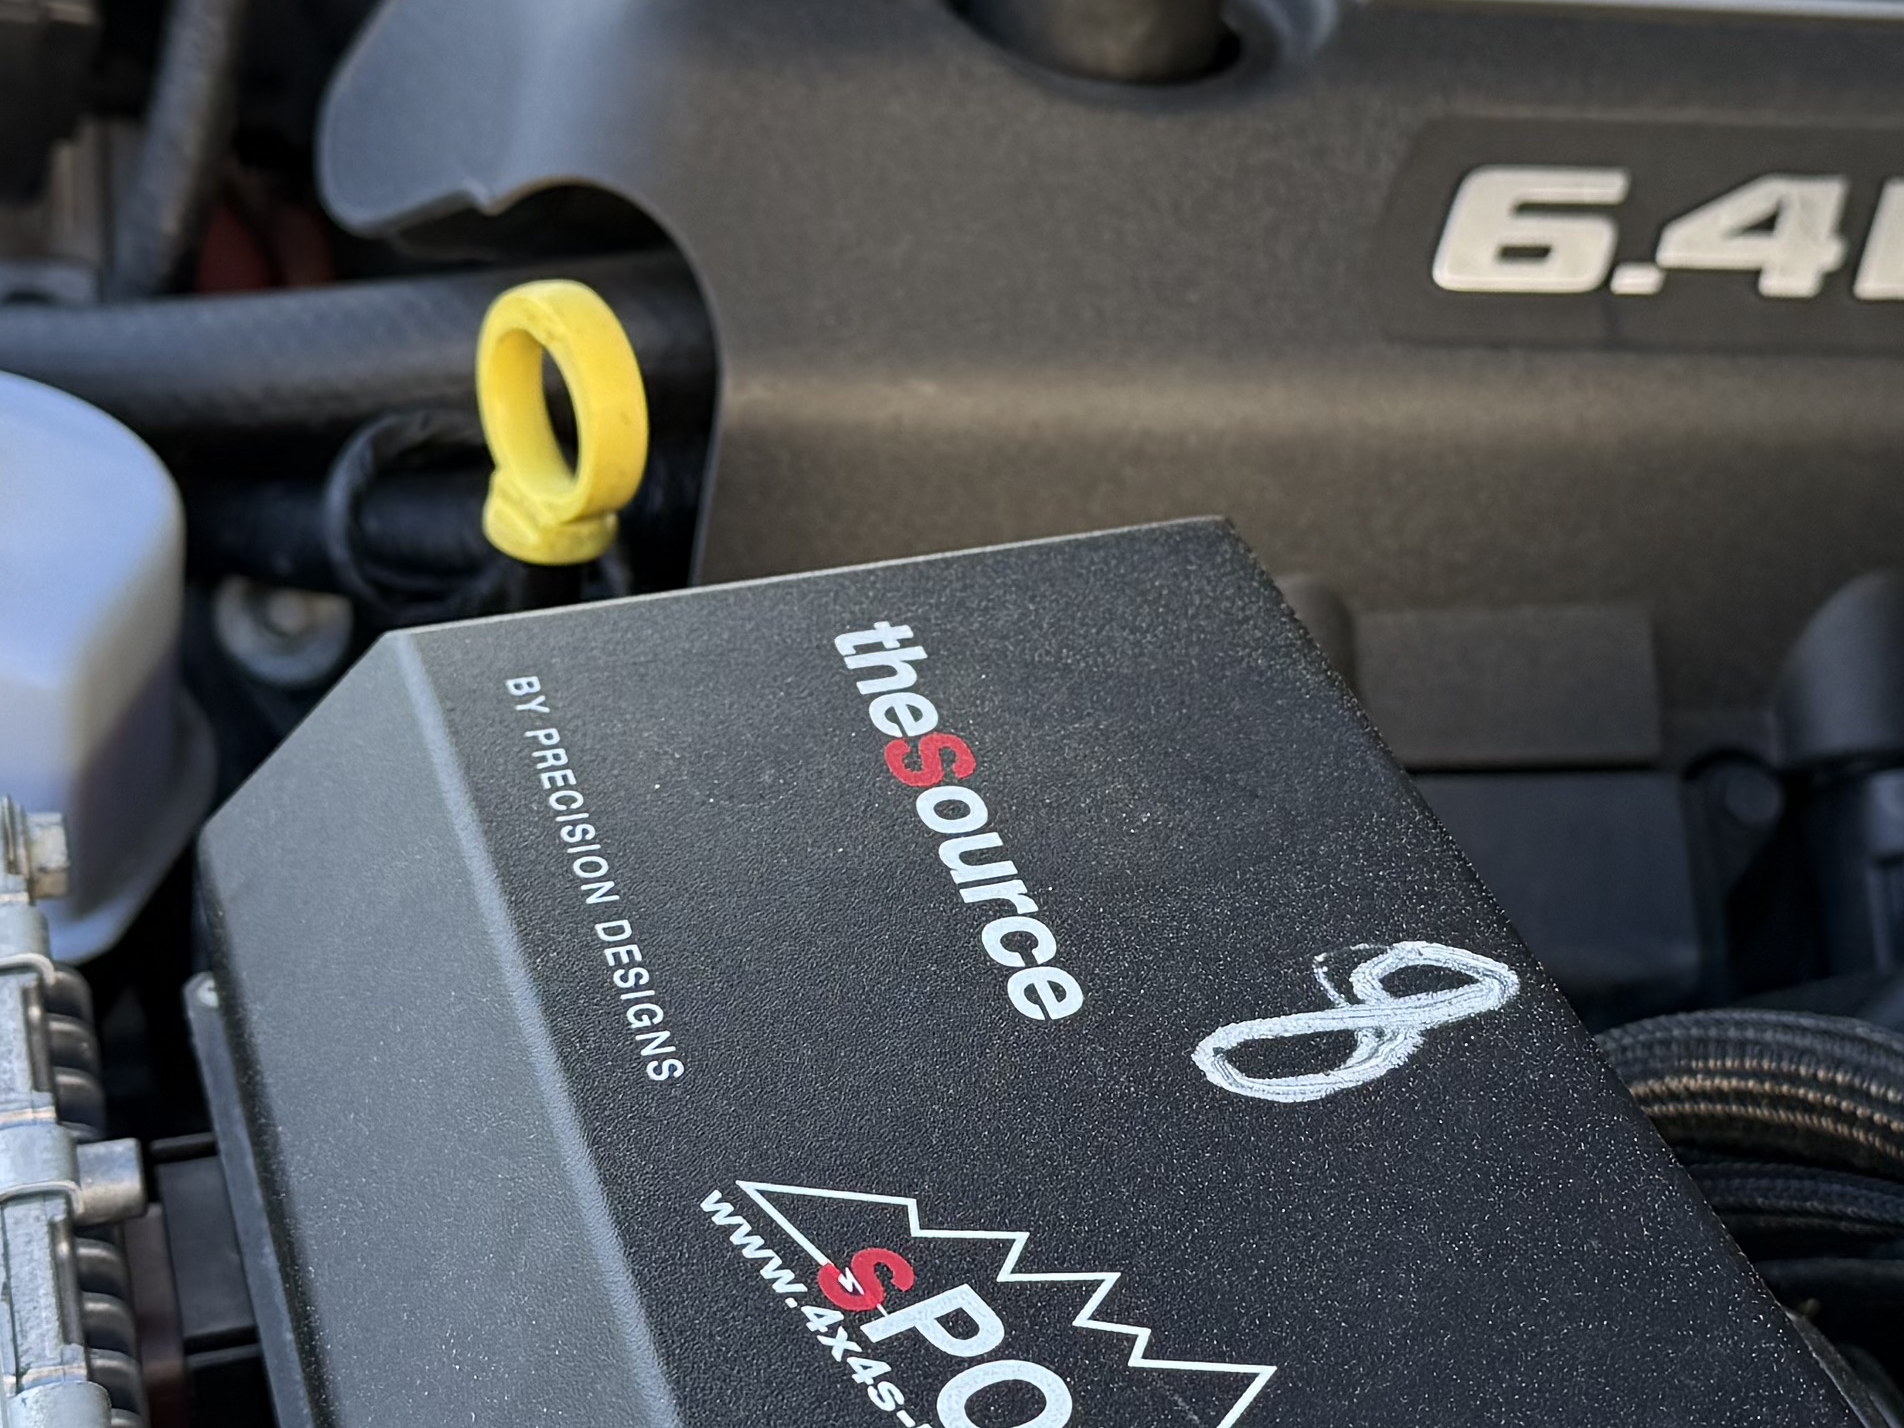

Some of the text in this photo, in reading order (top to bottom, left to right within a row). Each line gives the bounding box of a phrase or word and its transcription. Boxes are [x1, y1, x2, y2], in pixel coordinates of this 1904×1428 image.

[505, 675, 685, 1082] BY PRECISION DESIGNS
[834, 621, 1084, 1021] theSource
